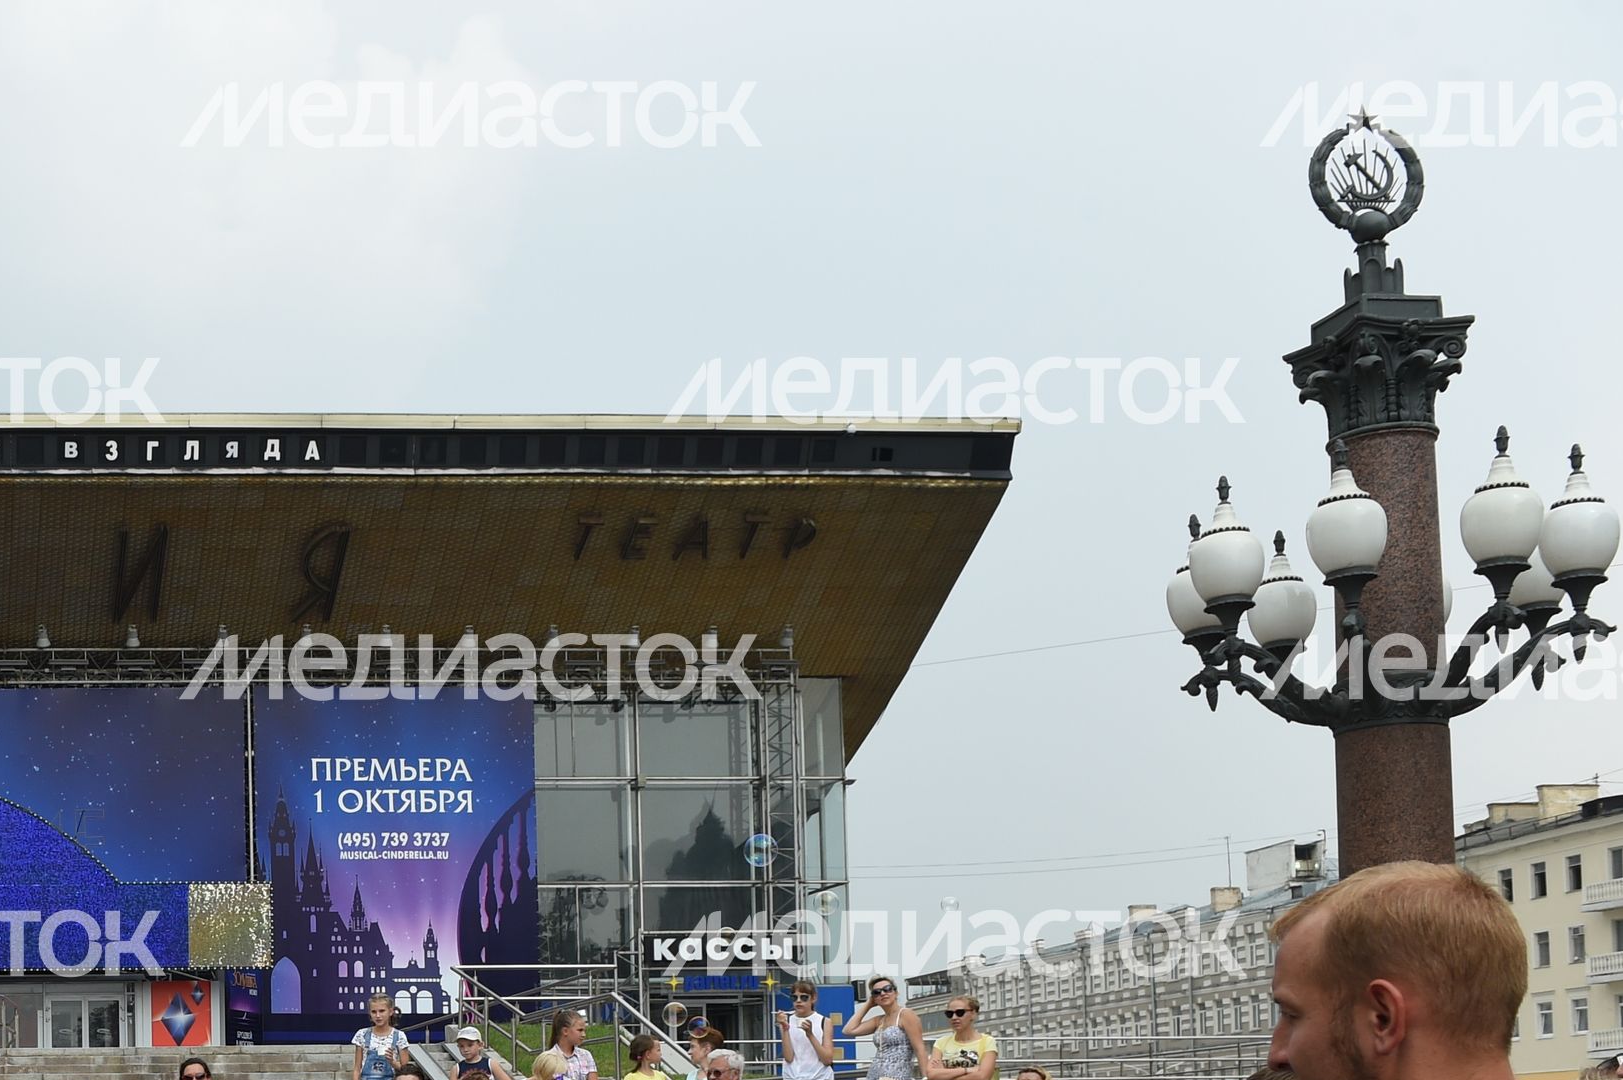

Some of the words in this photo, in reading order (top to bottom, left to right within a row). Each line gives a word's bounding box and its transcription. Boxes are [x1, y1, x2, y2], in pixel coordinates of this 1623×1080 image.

[64, 438, 320, 461] ВЗГЛЯДА
[572, 510, 819, 561] ТЕАТР
[311, 758, 473, 782] ПРЕМЬЕРА
[314, 789, 323, 813] 1
[337, 789, 473, 814] ОКТЯБРЯ
[337, 832, 377, 850] (495)
[381, 832, 409, 847] 739
[413, 831, 450, 847] 3737
[339, 850, 449, 860] MUSICAL-CINDERELLA.RU
